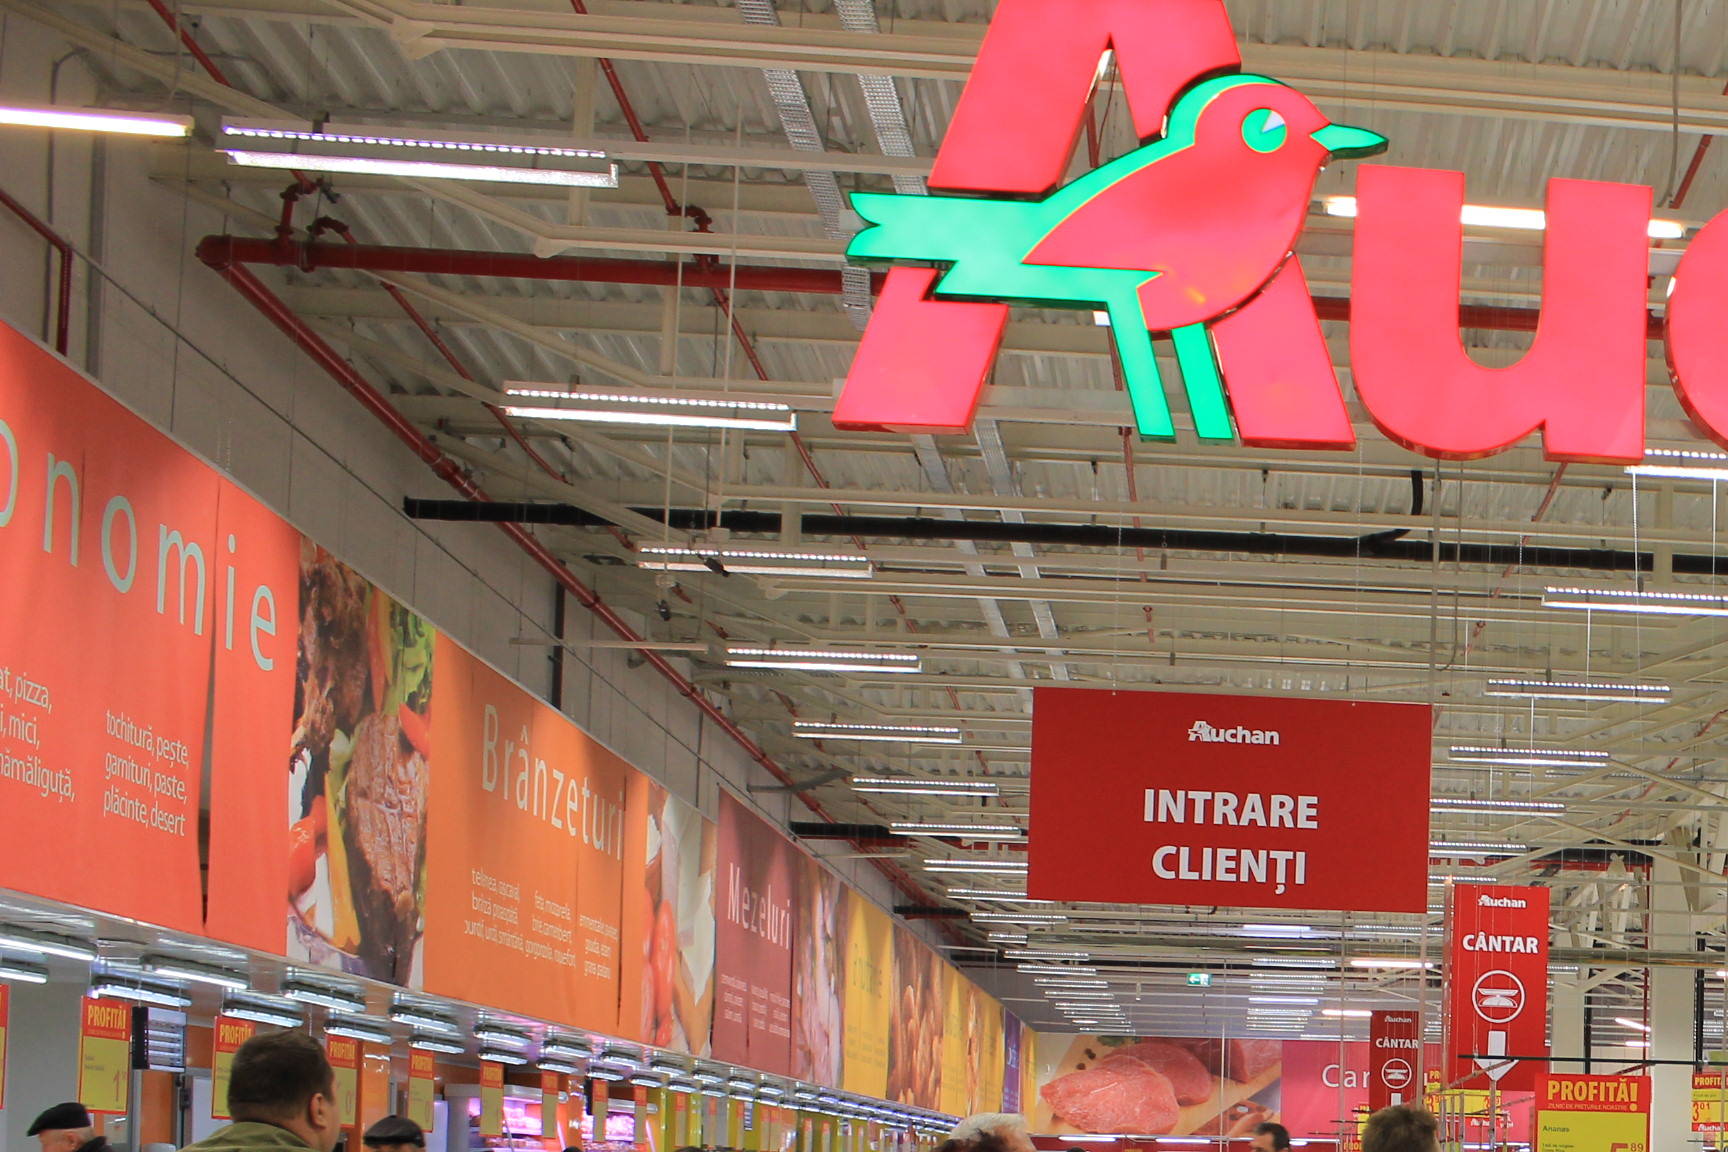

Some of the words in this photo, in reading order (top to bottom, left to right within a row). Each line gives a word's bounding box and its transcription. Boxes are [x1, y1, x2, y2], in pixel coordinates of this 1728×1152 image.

[15, 672, 52, 714] pizza,
[1187, 720, 1280, 745] Auchan
[0, 747, 76, 802] ămăliguță,
[481, 703, 622, 861] Brânzeturi
[150, 800, 186, 837] desert
[1143, 788, 1319, 830] INTRARE
[1151, 845, 1306, 895] CLIENȚI
[728, 862, 791, 949] Mezeluri
[1477, 894, 1526, 909] Auchan
[1462, 932, 1539, 954] CÂNTAR
[1376, 1036, 1418, 1049] CÂNTAR
[1547, 1078, 1638, 1111] PROFITĂ!
[1695, 1077, 1728, 1086] PROFIT!
